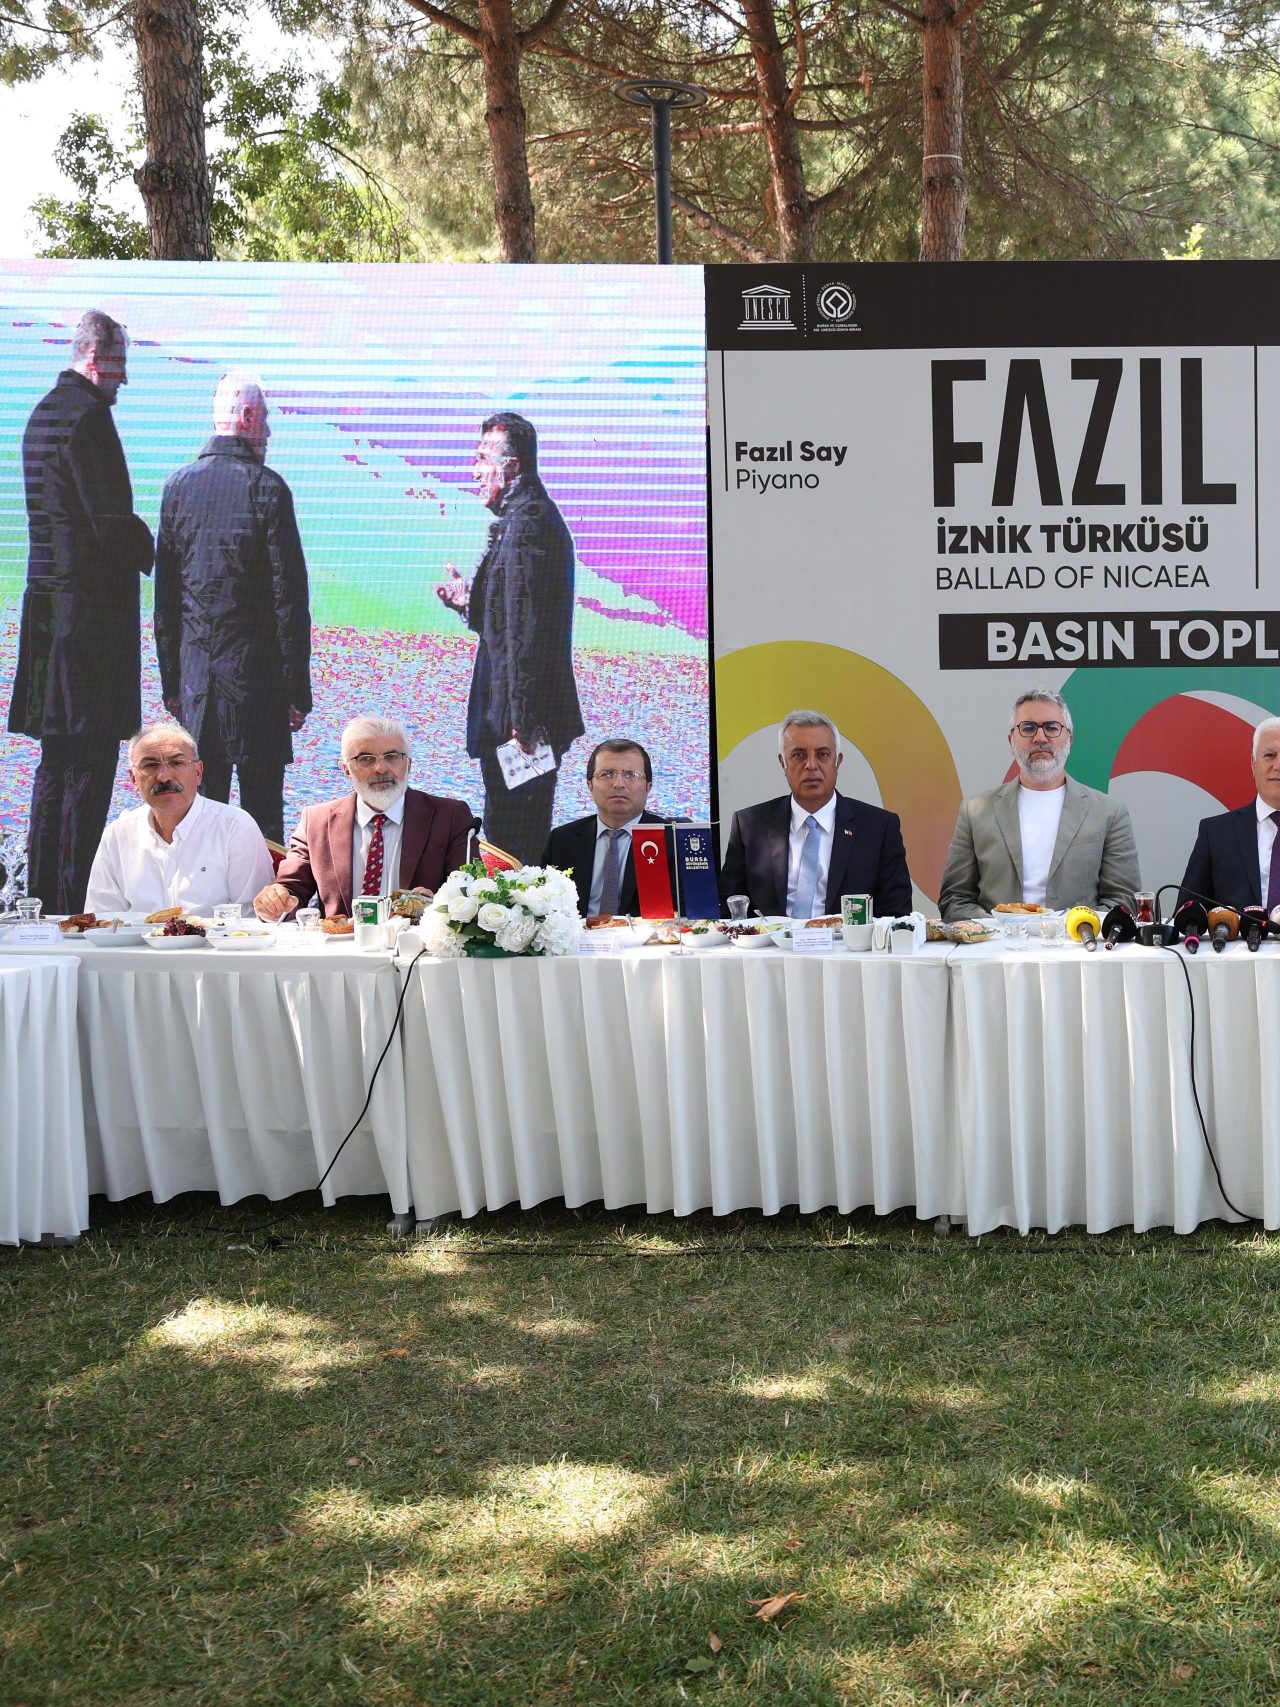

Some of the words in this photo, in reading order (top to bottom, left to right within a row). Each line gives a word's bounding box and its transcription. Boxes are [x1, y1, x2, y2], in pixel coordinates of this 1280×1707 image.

[744, 298, 789, 320] UNESCO
[931, 358, 1237, 507] FAZIL
[735, 441, 792, 462] Fazıl
[800, 441, 848, 466] Say
[736, 468, 820, 494] Piyano
[937, 516, 1033, 554] İZNİK
[1040, 516, 1209, 554] TÜRKÜSÜ
[936, 566, 1046, 590] BALLAD
[1054, 565, 1094, 589] OF
[1103, 564, 1210, 589] NICAEA
[987, 620, 1135, 662] BASIN
